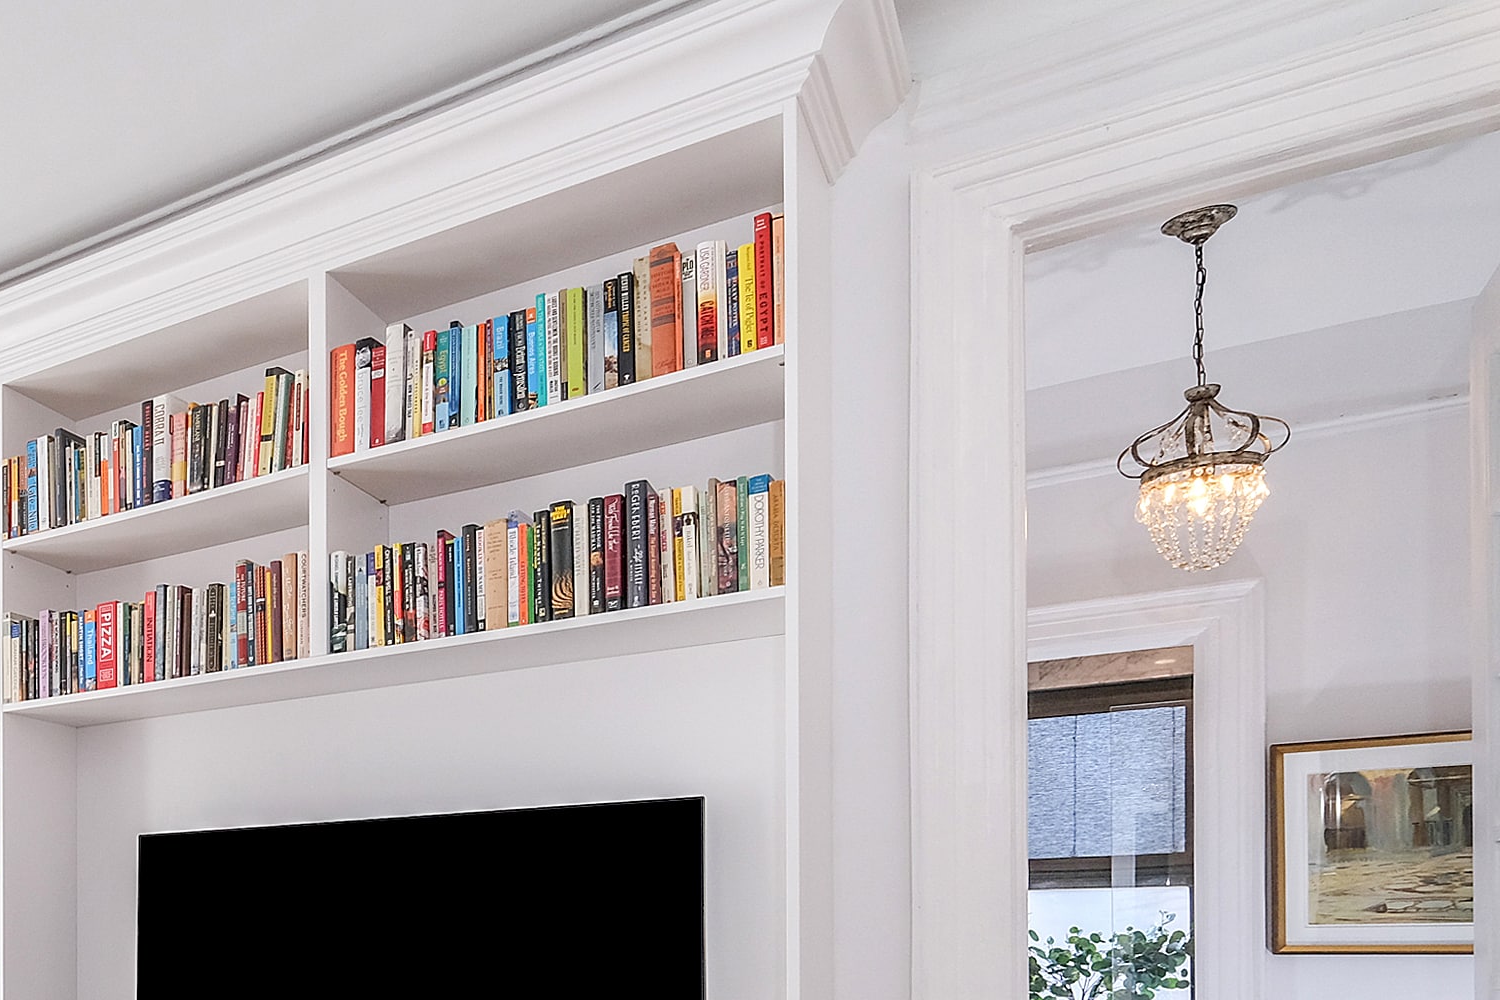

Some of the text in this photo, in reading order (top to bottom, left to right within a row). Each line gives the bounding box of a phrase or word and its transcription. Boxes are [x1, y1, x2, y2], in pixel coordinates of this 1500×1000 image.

[700, 247, 710, 292] LISA GARDNER
[745, 279, 754, 291] The
[746, 292, 754, 301] Te
[621, 292, 629, 311] MILLER
[759, 292, 767, 332] EGYPT
[622, 311, 630, 327] TROPIC
[700, 300, 715, 339] CATCH ME
[745, 311, 753, 333] Piglet
[496, 326, 505, 350] Brazil
[528, 332, 536, 357] Buenos
[622, 334, 630, 353] CANCER
[436, 350, 448, 373] Egypt
[337, 350, 348, 442] The Golden Bough
[357, 371, 367, 423] bruce lee
[154, 404, 165, 446] COBRA II
[631, 483, 641, 541] ROGER EBERT
[649, 499, 657, 519] Norman
[649, 519, 657, 536] Mailer
[754, 495, 765, 570] DOROTHY PARKER
[509, 556, 517, 580] Island
[87, 629, 95, 665] Thailand
[100, 612, 112, 659] PIZZA
